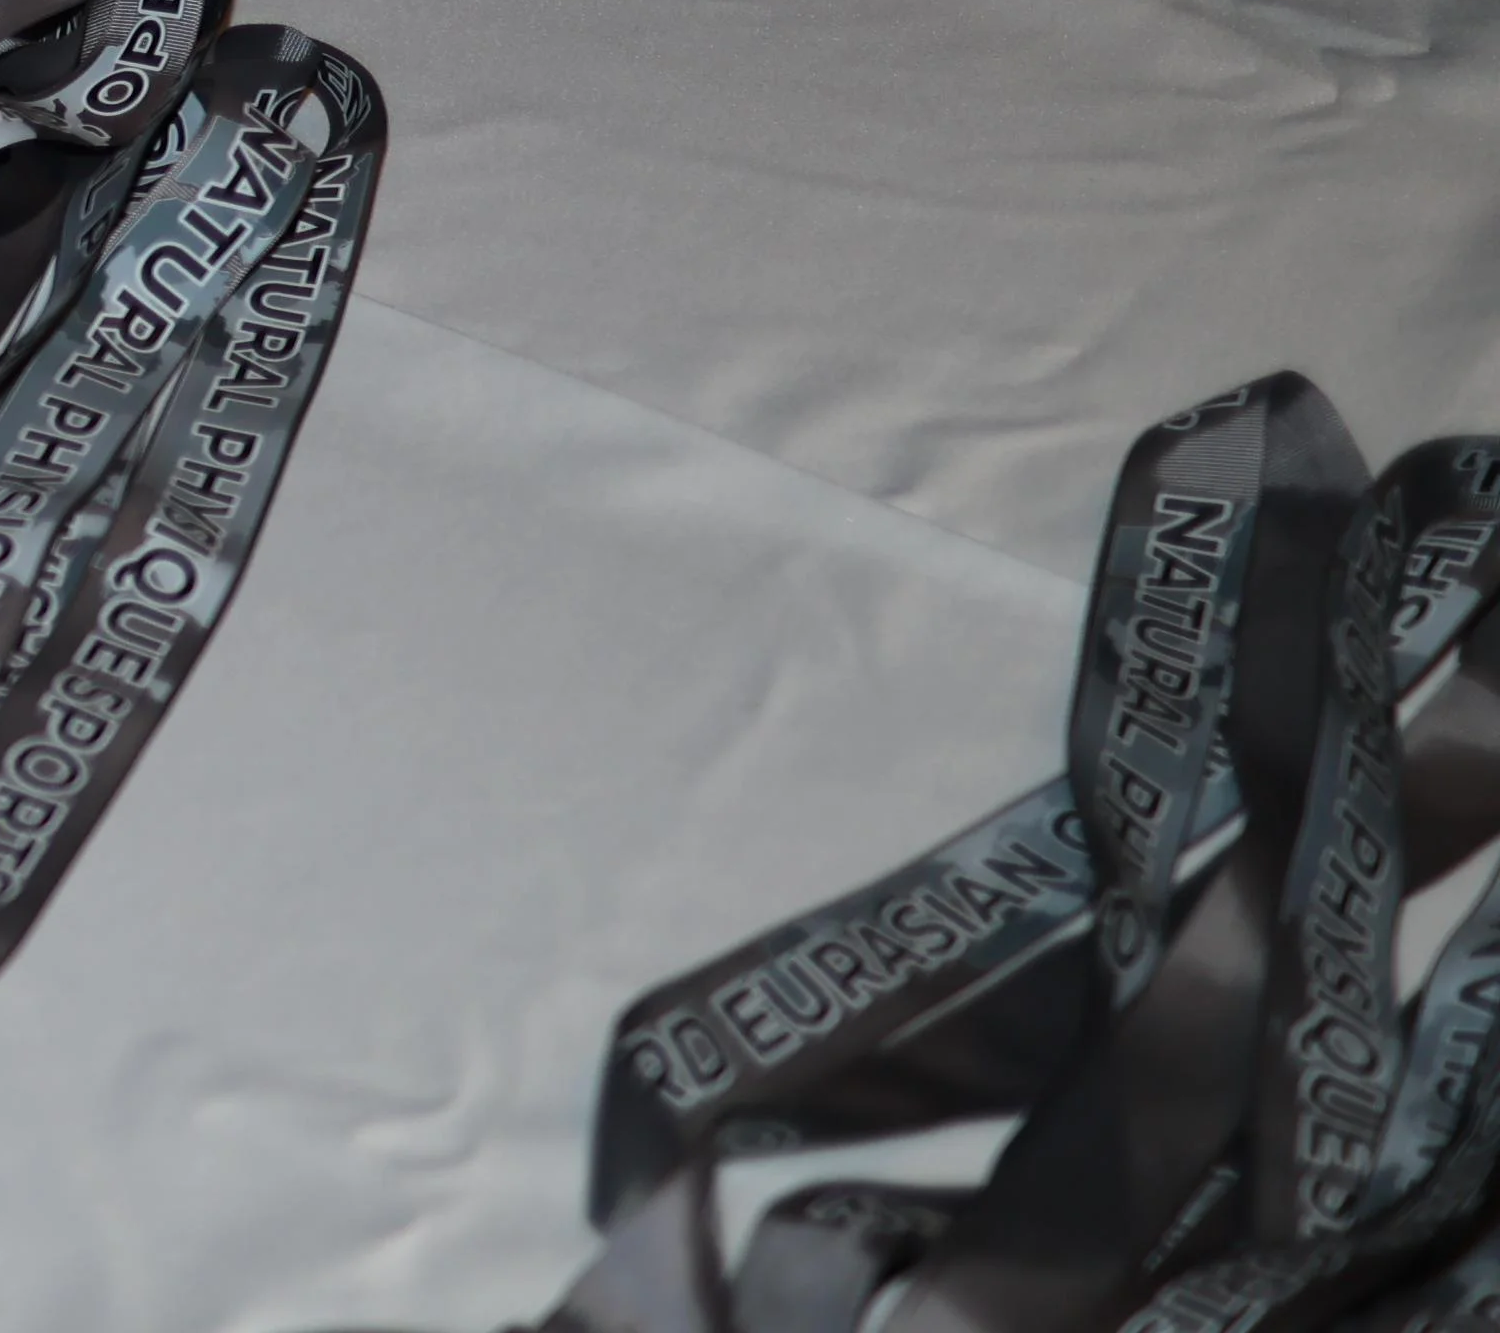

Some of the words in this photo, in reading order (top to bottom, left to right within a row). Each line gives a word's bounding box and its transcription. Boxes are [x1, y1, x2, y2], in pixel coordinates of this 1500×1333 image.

[58, 111, 302, 394] NATURAL
[204, 152, 355, 412] NATURAL
[70, 421, 262, 691] PHYSIQUE
[1102, 491, 1238, 757] NATURAL
[623, 1008, 737, 1116] RD
[718, 835, 1052, 1069] EURASIAN
